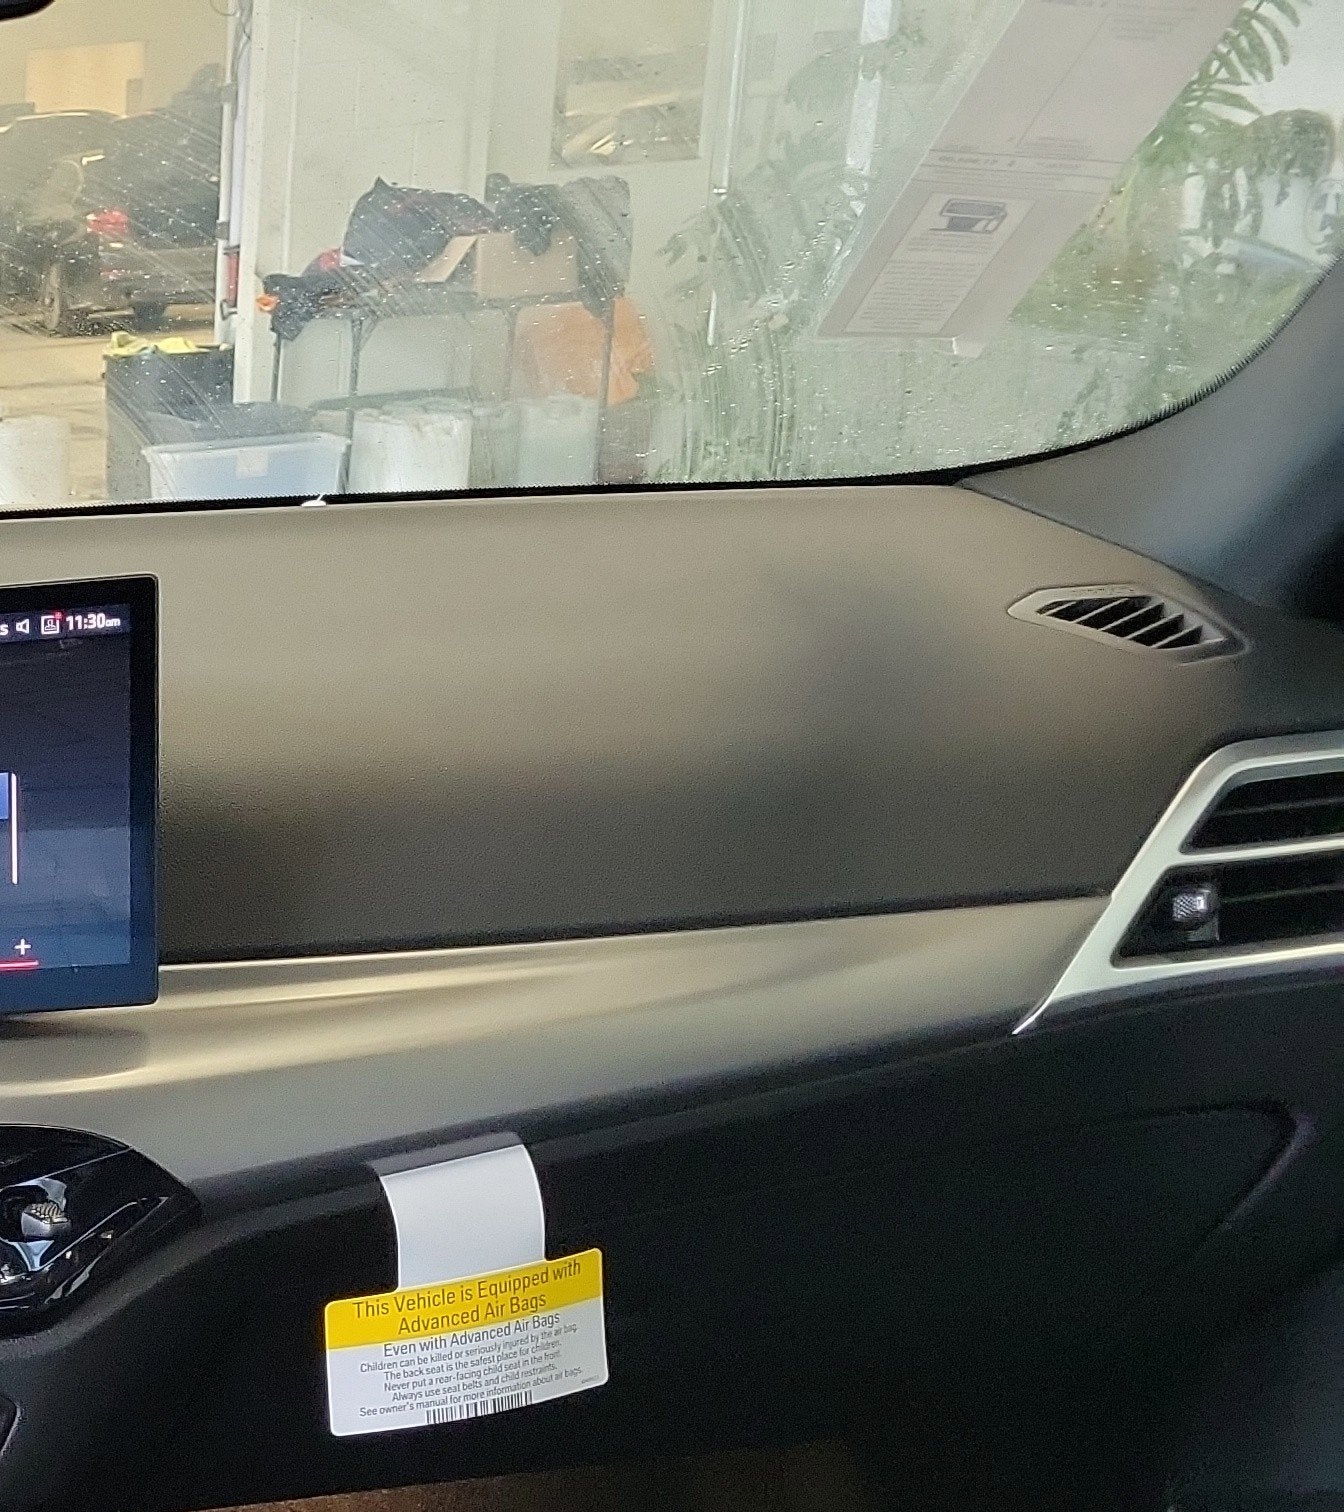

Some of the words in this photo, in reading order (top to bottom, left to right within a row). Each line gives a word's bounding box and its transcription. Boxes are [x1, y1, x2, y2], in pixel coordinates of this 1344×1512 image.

[352, 1299, 389, 1318] This
[394, 1288, 456, 1312] Vehicle
[461, 1285, 473, 1302] is
[478, 1267, 549, 1298] Equipped
[553, 1260, 581, 1280] with
[398, 1305, 479, 1335] Advanced
[485, 1301, 506, 1319] Air
[510, 1294, 547, 1313] Bags
[360, 1361, 398, 1372] Children
[400, 1359, 415, 1368] can
[417, 1356, 428, 1365] be
[430, 1351, 452, 1363] killed
[465, 1342, 501, 1357] seriously
[503, 1334, 529, 1349] injured
[531, 1334, 539, 1343] by
[384, 1343, 417, 1357] Even
[419, 1336, 447, 1352] with
[450, 1322, 511, 1347] Advanced
[514, 1319, 529, 1334] Air
[532, 1313, 560, 1329] Bags
[384, 1371, 401, 1380] The
[403, 1367, 424, 1378] back
[426, 1364, 444, 1375] seat
[446, 1363, 453, 1371] is
[455, 1361, 468, 1370] the
[470, 1355, 495, 1367] safest
[497, 1351, 518, 1363] place
[384, 1382, 410, 1391] Never
[412, 1379, 426, 1389] put
[435, 1370, 481, 1385] rear-facing
[483, 1364, 502, 1375] child
[504, 1361, 520, 1371] seat
[360, 1407, 377, 1417] See
[379, 1402, 414, 1414] owner's
[416, 1396, 448, 1409] manual
[450, 1395, 461, 1404] for
[463, 1391, 485, 1401] more
[486, 1381, 530, 1397] information
[392, 1391, 422, 1402] Always
[425, 1388, 440, 1398] use
[442, 1384, 461, 1395] seat
[462, 1380, 482, 1391] belts
[485, 1375, 499, 1386] and
[501, 1371, 520, 1383] child
